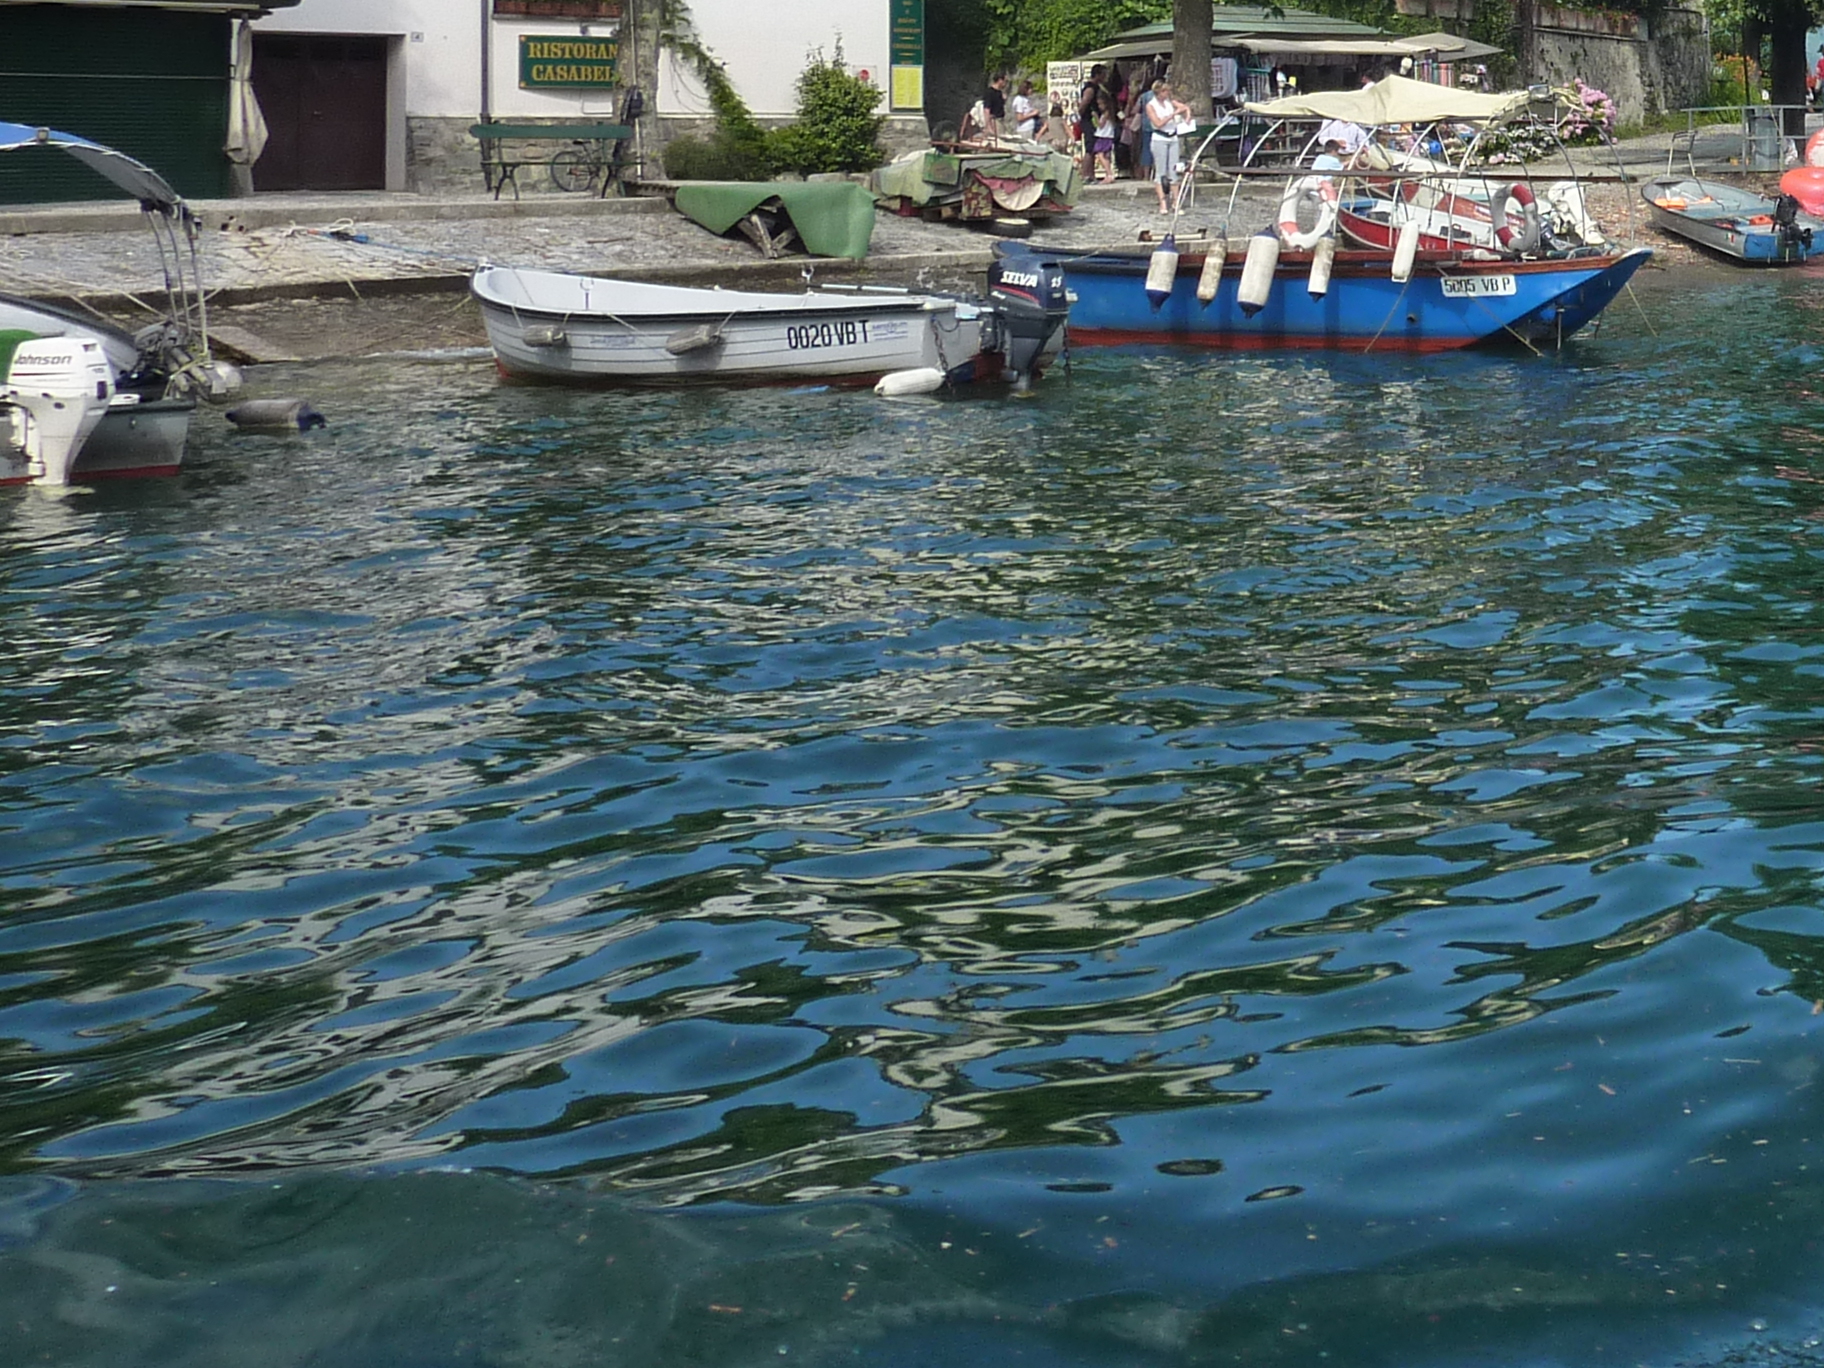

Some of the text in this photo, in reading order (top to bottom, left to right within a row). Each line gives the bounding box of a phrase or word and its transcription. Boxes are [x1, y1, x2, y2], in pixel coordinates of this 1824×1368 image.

[1000, 271, 1038, 288] SELVA
[1481, 277, 1499, 292] VB
[1502, 277, 1510, 291] P
[787, 324, 832, 349] 0020
[834, 320, 857, 346] VB
[858, 319, 869, 343] T
[14, 354, 72, 365] Johnson
